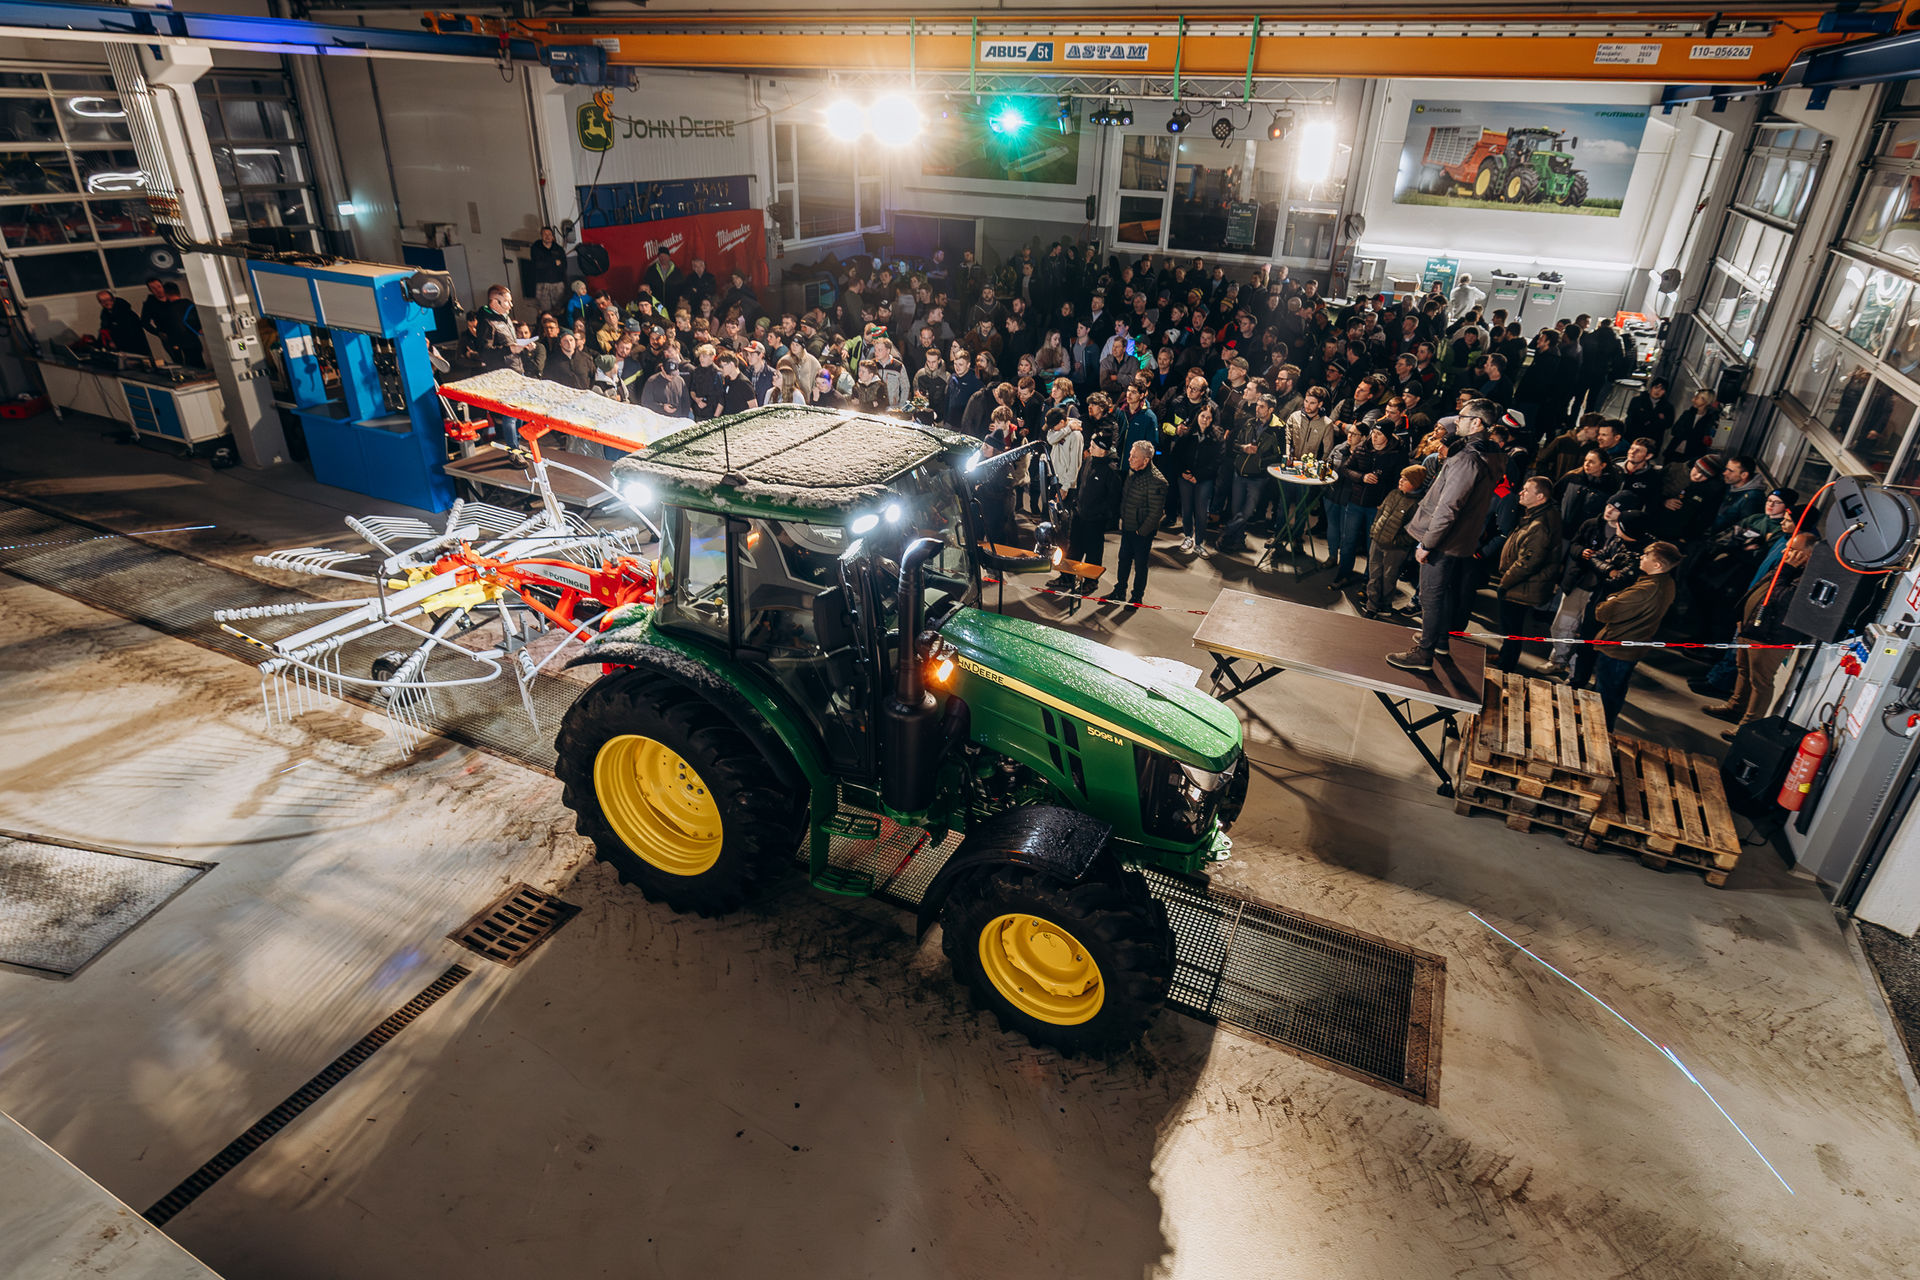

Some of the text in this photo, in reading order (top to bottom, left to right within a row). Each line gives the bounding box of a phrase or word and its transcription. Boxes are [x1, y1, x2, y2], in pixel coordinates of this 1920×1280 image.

[985, 42, 1049, 59] ABUS 5t
[1066, 44, 1148, 60] ASTAM
[1692, 46, 1751, 57] 110-056263
[622, 114, 736, 139] JOHN DEERE
[716, 223, 752, 249] Milwaukee
[972, 663, 1005, 685] DEERE
[1087, 725, 1124, 747] 5095 M
